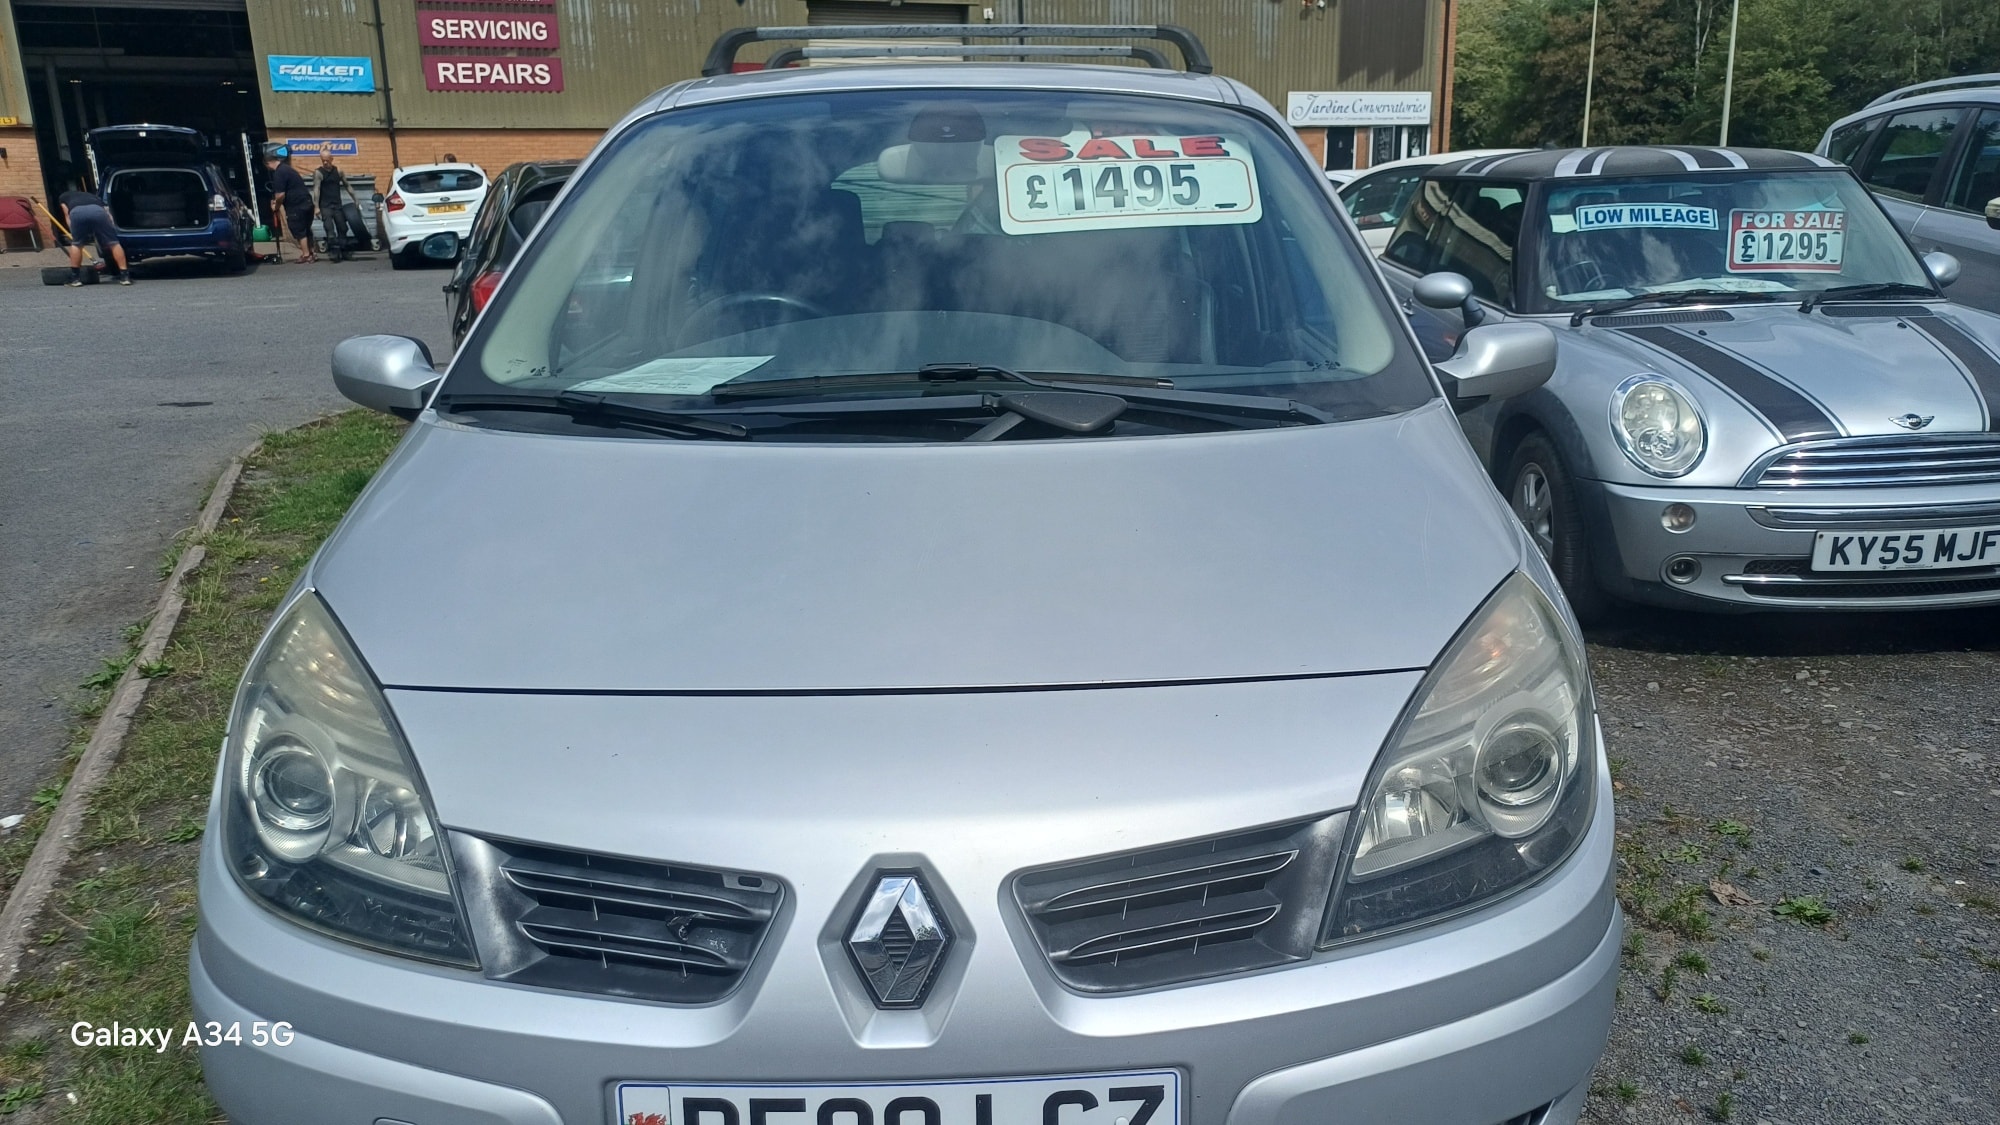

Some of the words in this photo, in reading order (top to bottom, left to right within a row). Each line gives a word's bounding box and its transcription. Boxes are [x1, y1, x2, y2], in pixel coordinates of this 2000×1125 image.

[431, 18, 548, 41] SERVICING
[279, 64, 364, 77] FALKEN
[437, 62, 551, 85] REPAIRS
[1291, 93, 1350, 121] Jardine
[1351, 98, 1427, 114] Conservatories
[291, 143, 352, 152] GOODYEAR
[1018, 136, 1231, 162] SALE
[1026, 163, 1201, 211] £1495
[1583, 208, 1623, 226] LOW
[1629, 207, 1711, 225] MILEAGE
[1740, 212, 1786, 229] FOR
[1793, 212, 1844, 230] SALE
[1740, 232, 1829, 261] £1295
[1829, 534, 1925, 566] KY55
[1933, 530, 2000, 563] MJF
